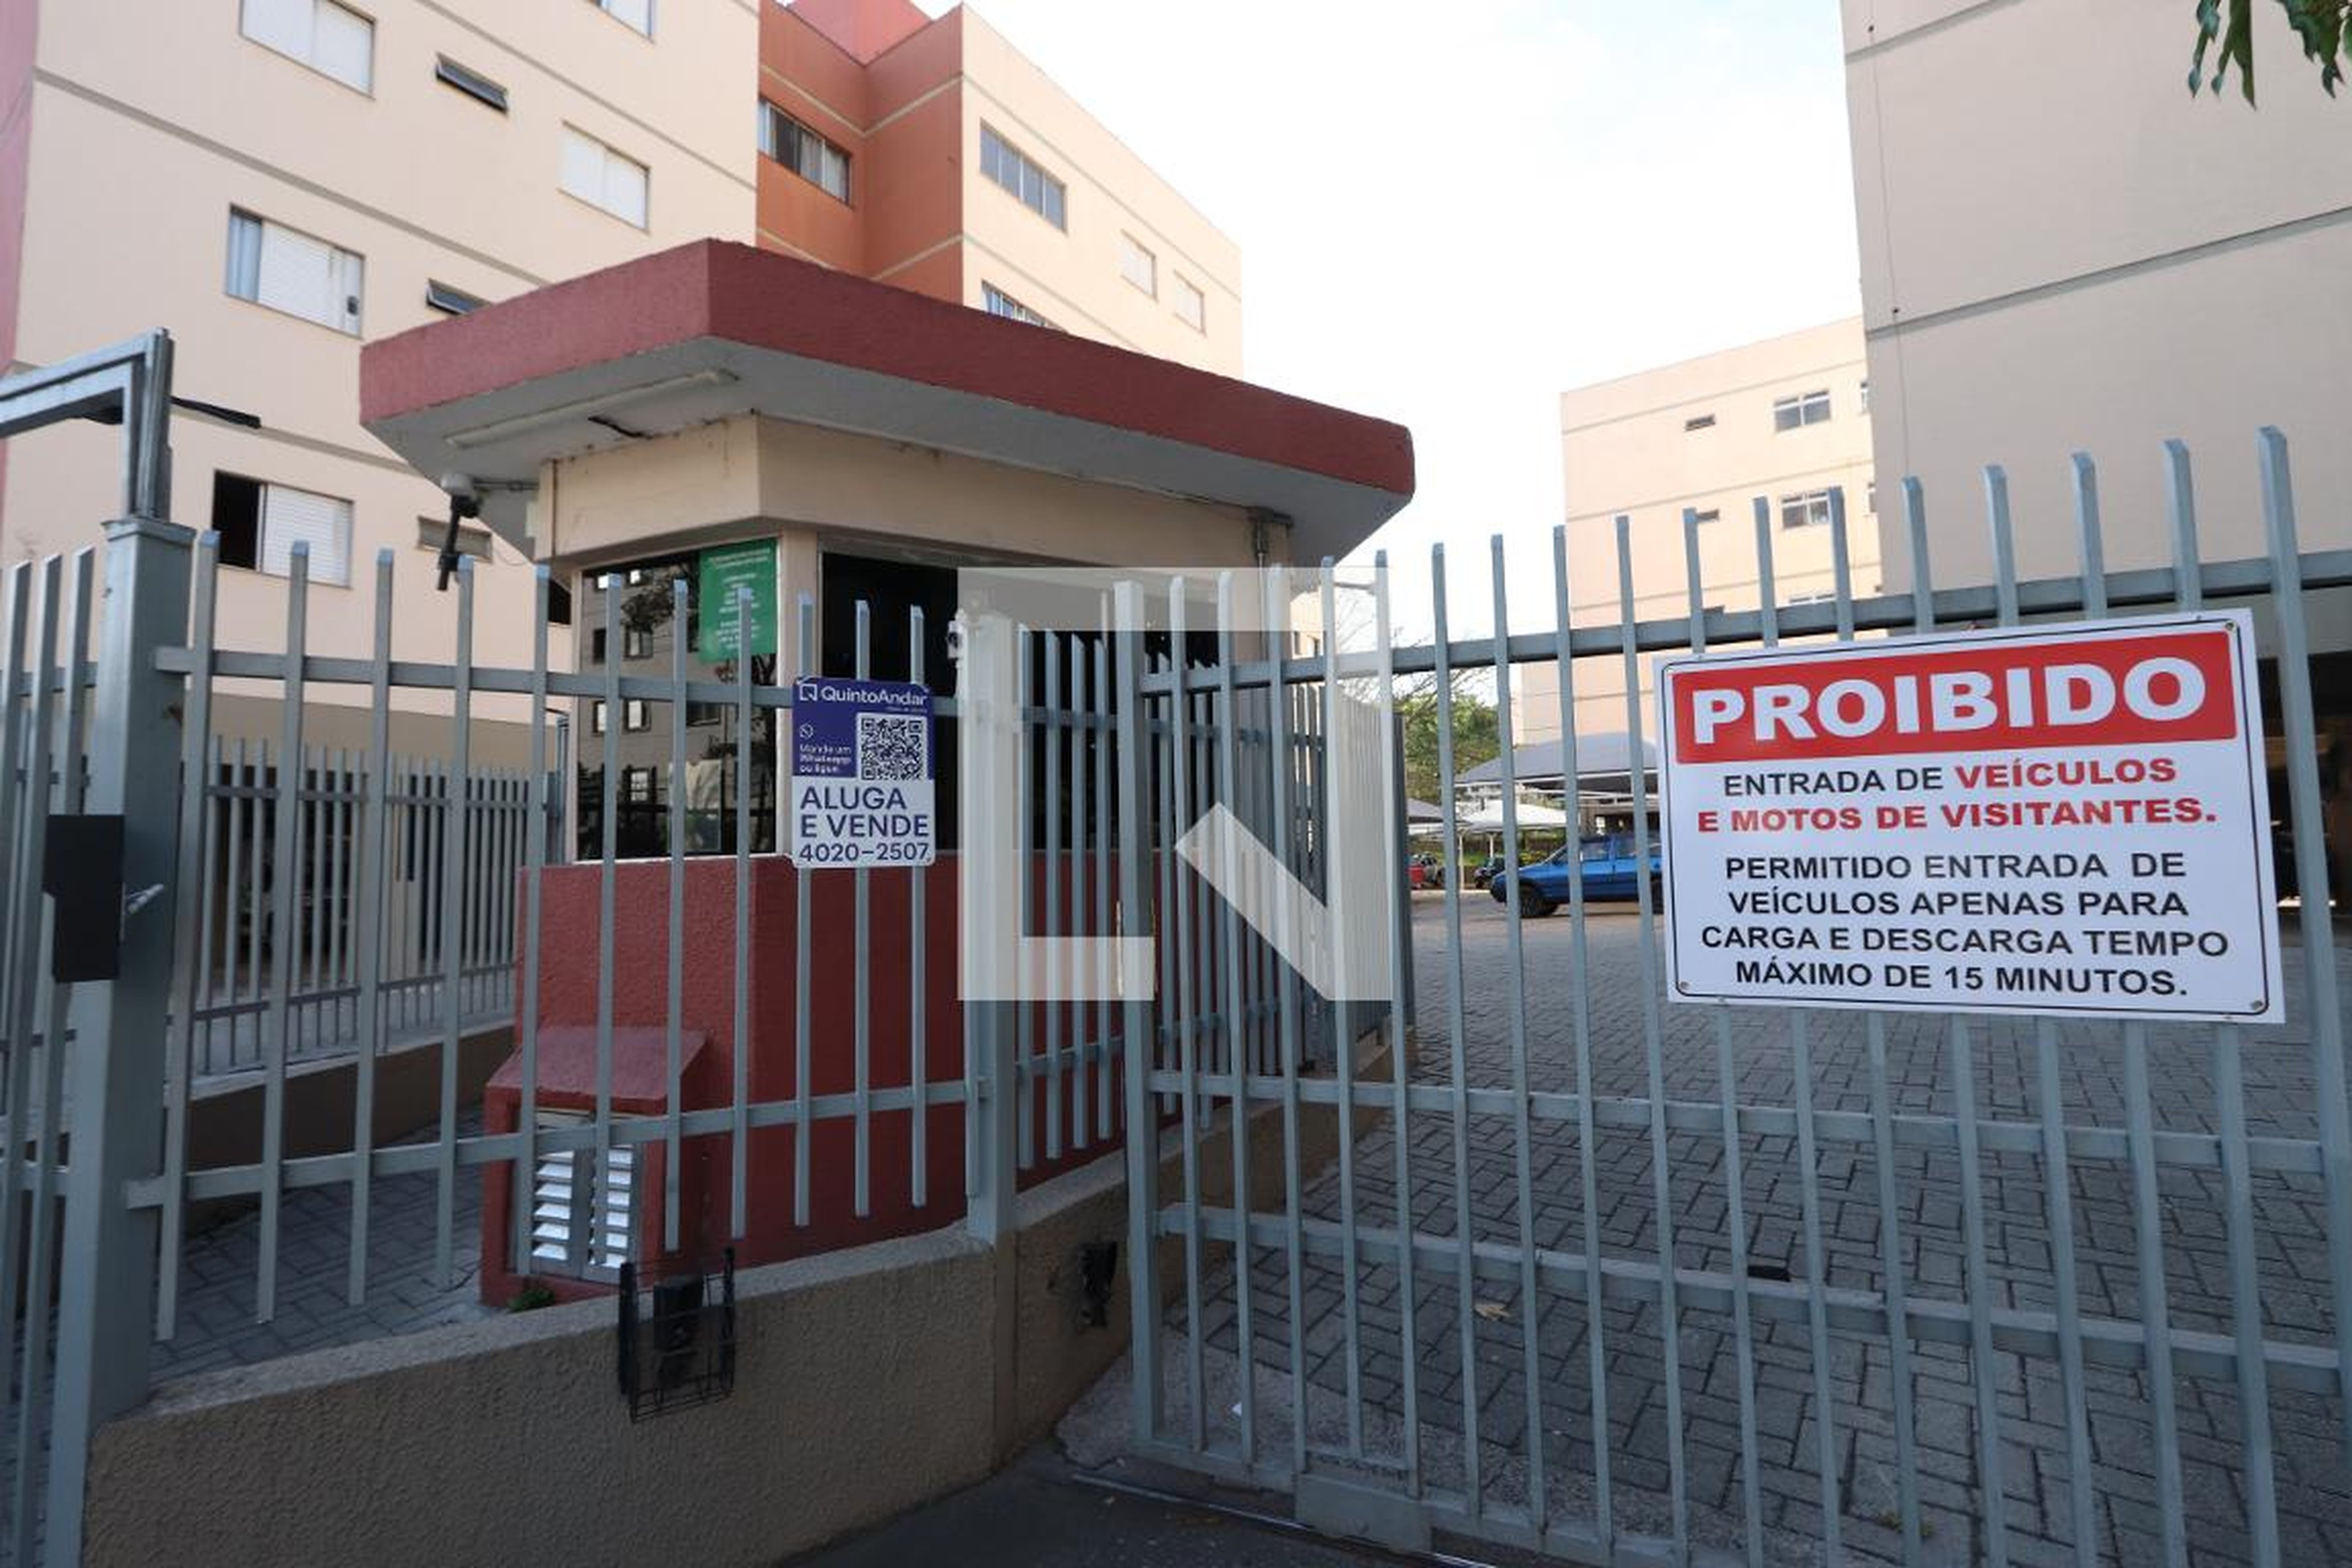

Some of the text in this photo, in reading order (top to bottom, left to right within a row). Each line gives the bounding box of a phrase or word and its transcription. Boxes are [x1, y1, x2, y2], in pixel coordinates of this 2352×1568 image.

[821, 686, 927, 705] QuintoAndar
[1692, 657, 2206, 744] PROIBIDO
[1723, 757, 2176, 797] ENTRADA DE VEÍCULOS
[800, 786, 907, 810] ALUGA
[801, 815, 929, 838] E VENDE
[1698, 797, 2217, 833] E MOTOS DE VISITANTES.
[800, 842, 929, 862] 4020-2507
[1725, 852, 2187, 880] PERMITIDO ENTRADA DE
[1728, 884, 2189, 917] VEÍCULOS APENAS PARA
[1702, 925, 2228, 957] CARGA E DESCARGA TEMPO
[1736, 956, 2187, 997] MÁXIMO DE 15 MINUTOS.
